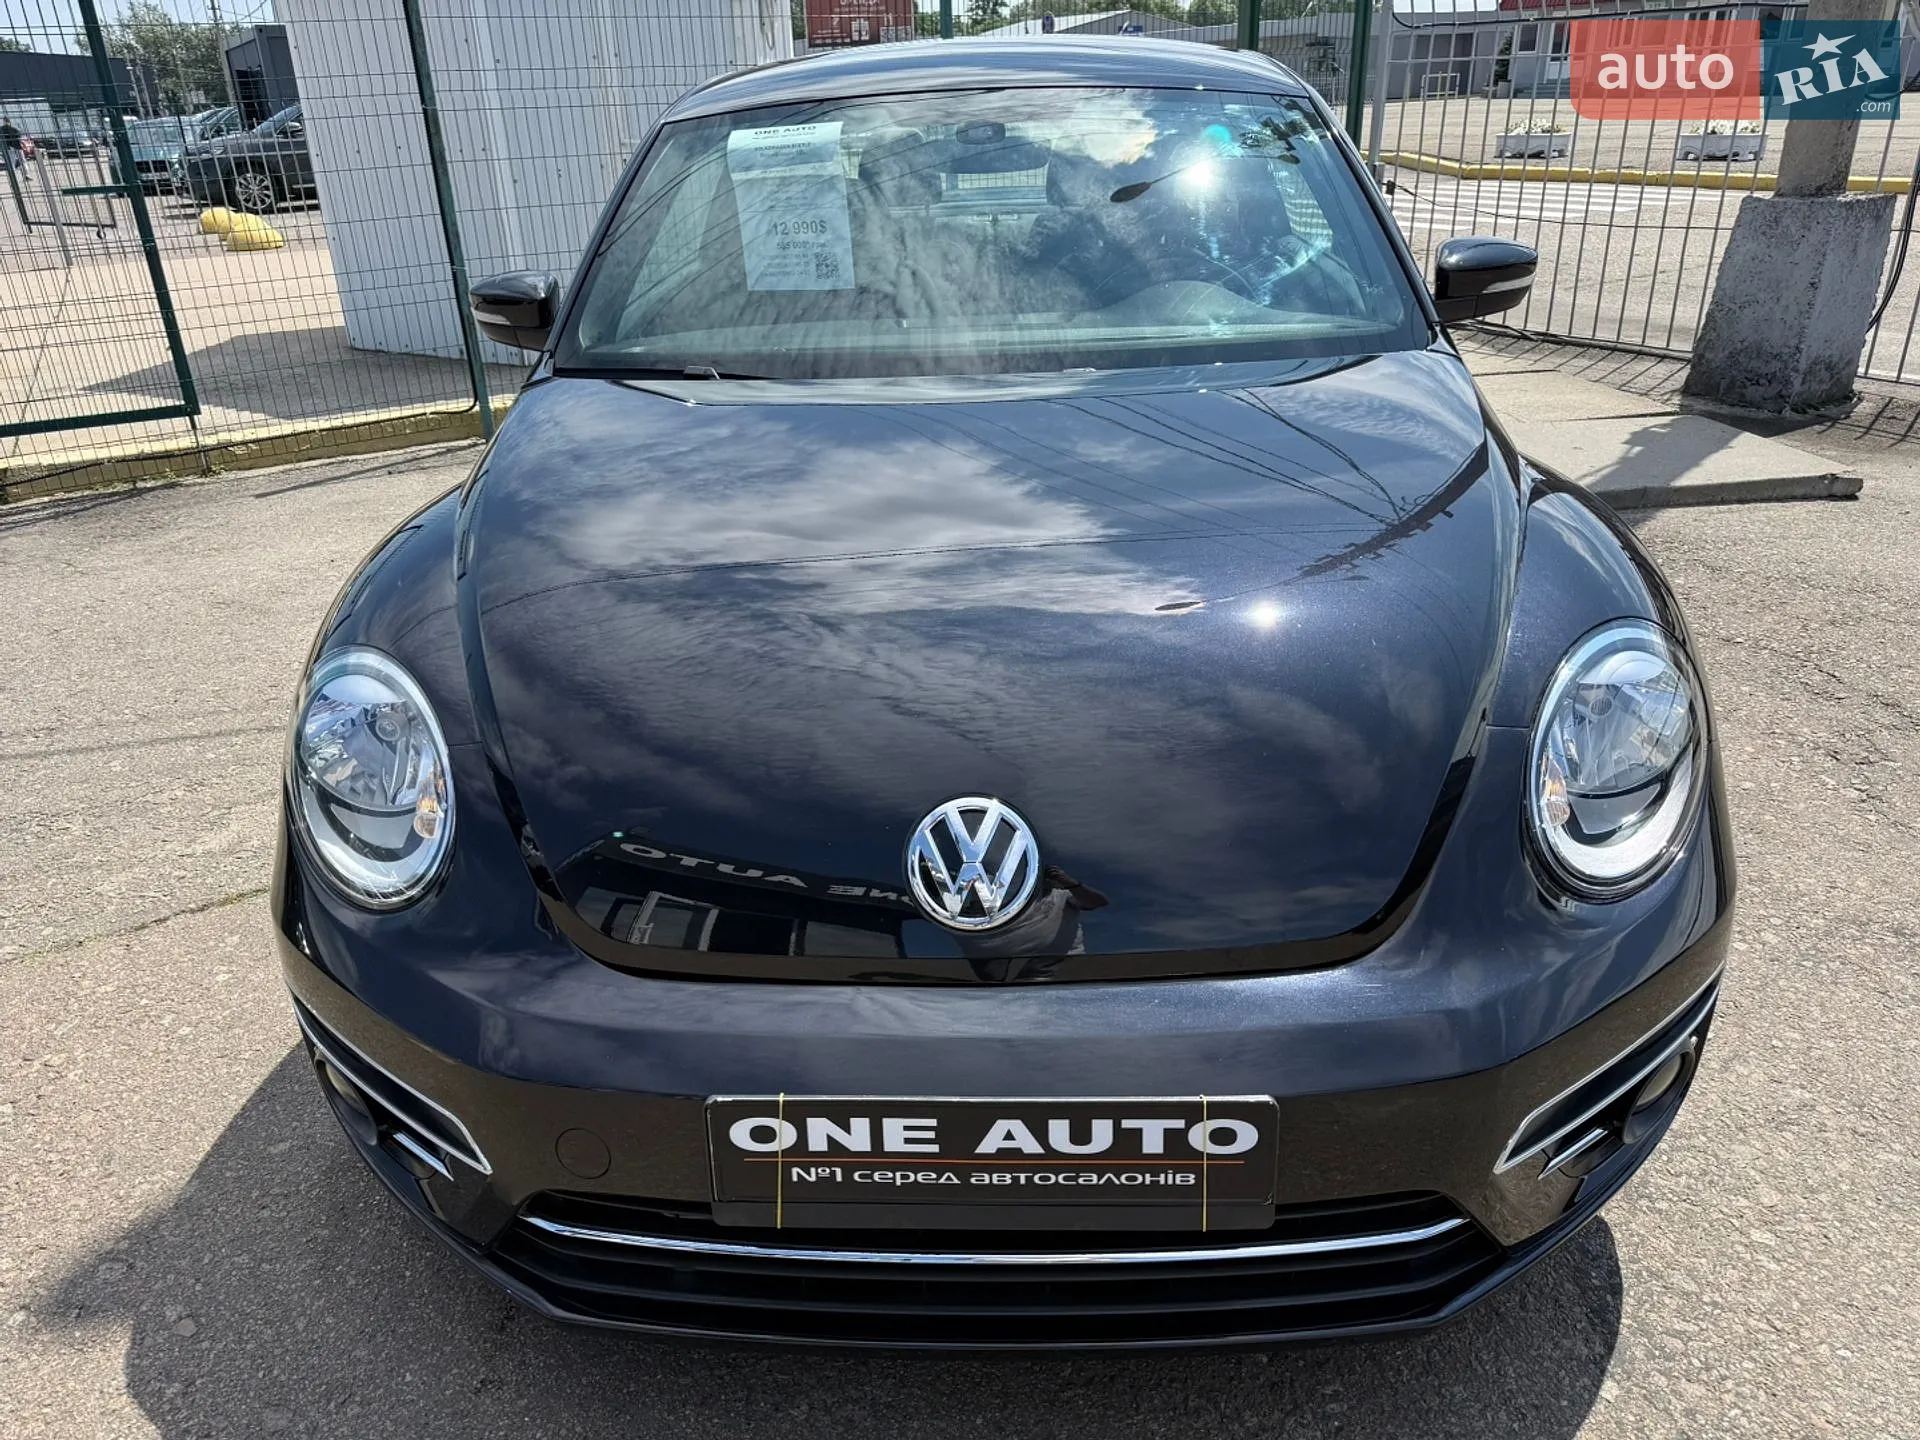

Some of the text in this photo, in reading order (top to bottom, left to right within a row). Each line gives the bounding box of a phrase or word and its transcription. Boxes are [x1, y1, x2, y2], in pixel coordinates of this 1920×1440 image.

[772, 219, 828, 236] 12 990$
[729, 1117, 1259, 1155] ONE AUTO
[853, 1170, 961, 1187] серед
[970, 1170, 1196, 1186] автосалонів
